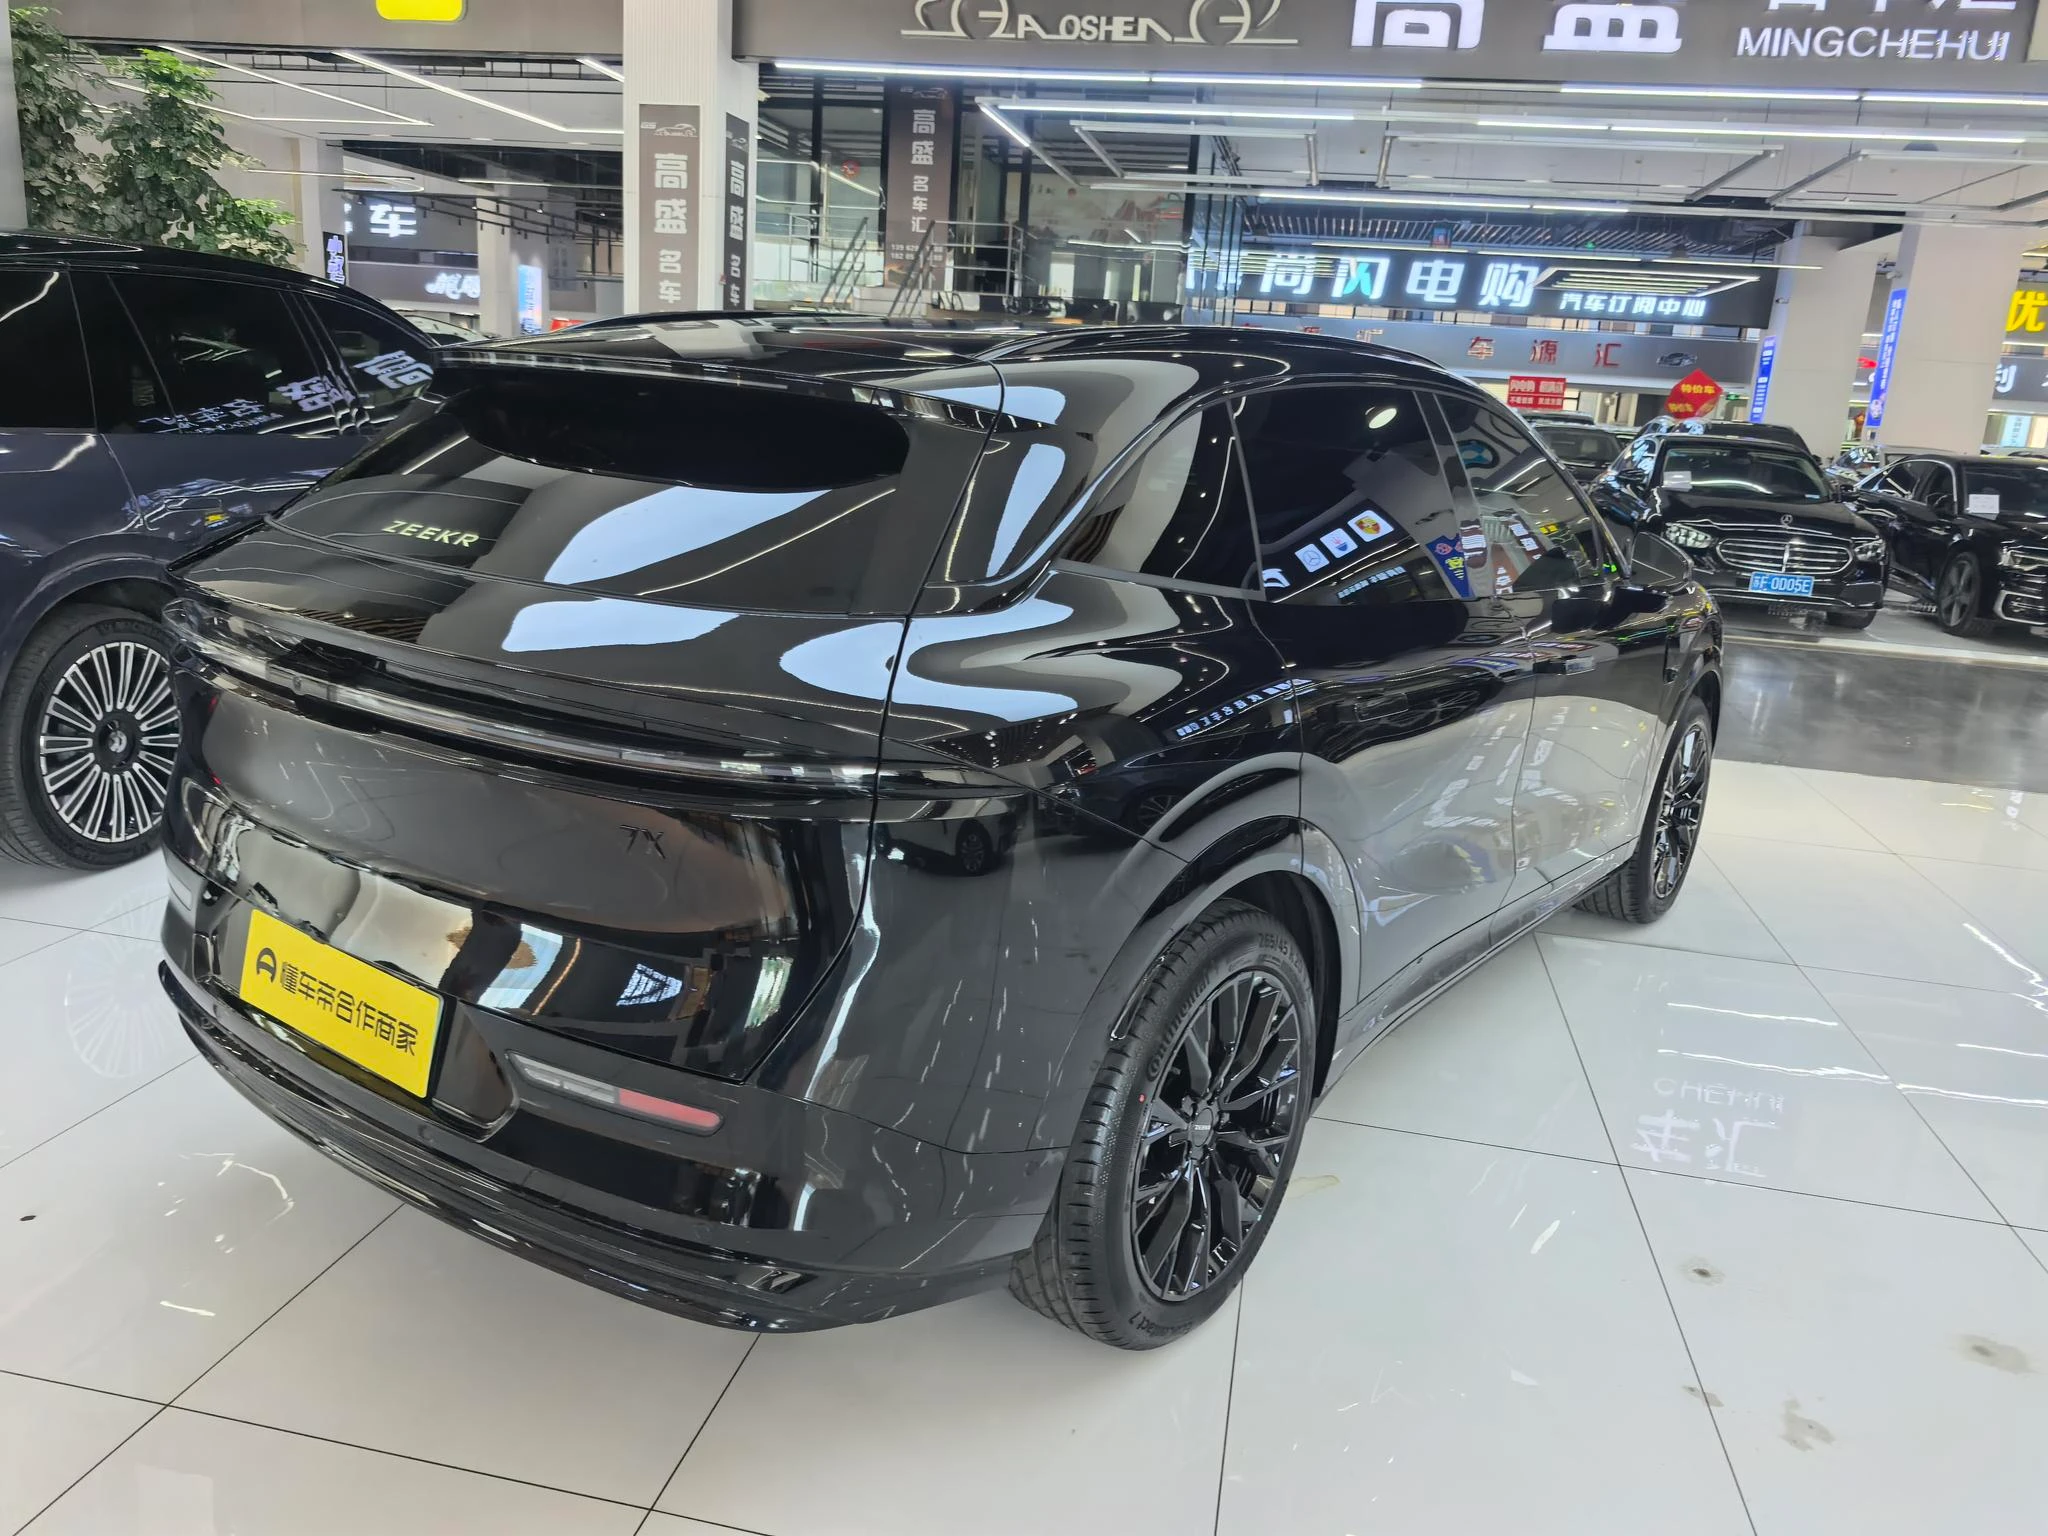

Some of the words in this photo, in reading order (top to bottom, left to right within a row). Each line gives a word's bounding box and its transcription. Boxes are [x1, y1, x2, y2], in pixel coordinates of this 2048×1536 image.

[1736, 26, 2012, 61] MINGCHEHUI
[1559, 290, 1709, 319] 汽车订阅中心
[2006, 289, 2048, 333] 优
[1466, 335, 1623, 368] 车源汇
[381, 520, 480, 547] ZEEKR
[619, 824, 667, 860] 7X
[280, 960, 419, 1057] 懂车帝合作商家
